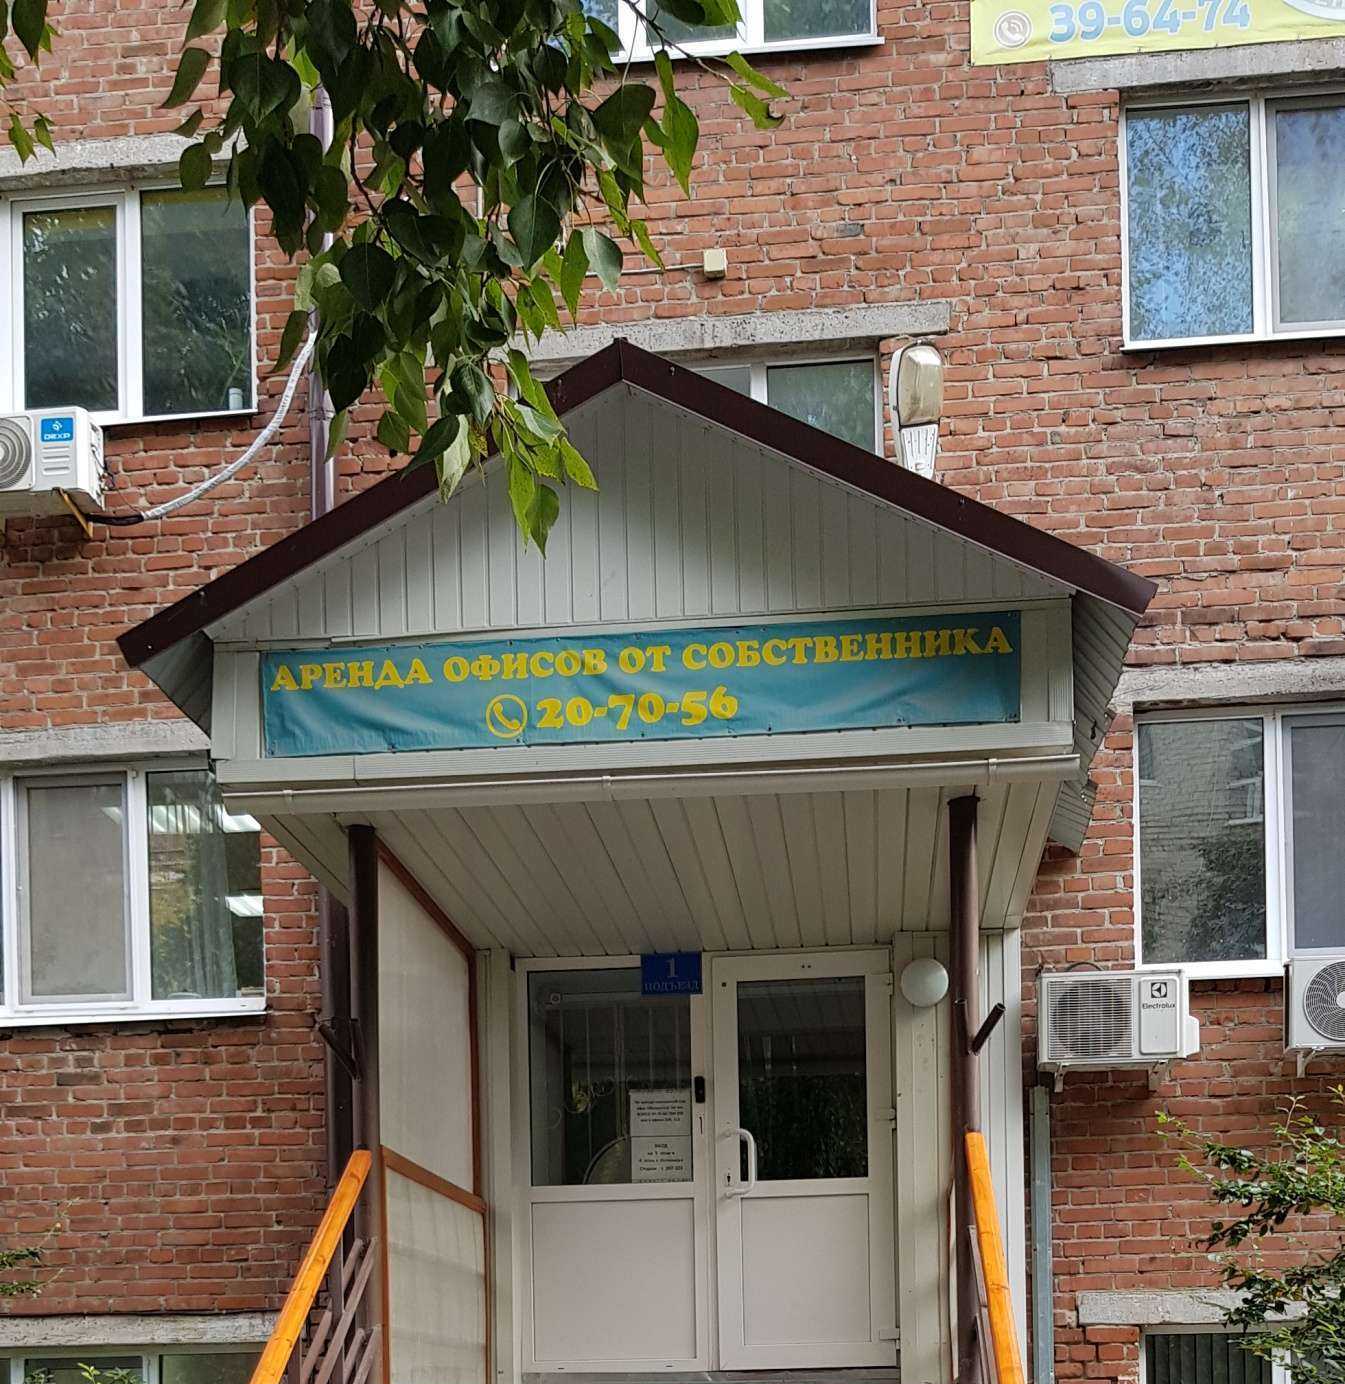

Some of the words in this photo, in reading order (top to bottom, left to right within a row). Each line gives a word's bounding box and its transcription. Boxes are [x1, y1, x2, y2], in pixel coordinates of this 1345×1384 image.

[1048, 0, 1252, 43] 39-64-74
[270, 658, 432, 691] АРЕНДА
[443, 648, 607, 683] ОФИСОВ
[618, 645, 671, 675] ОТ
[682, 627, 1013, 671] СОБСТВЕННИКА
[536, 684, 738, 730] 20-70-56
[665, 958, 679, 979] 1
[1142, 1002, 1176, 1010] Electrolux
